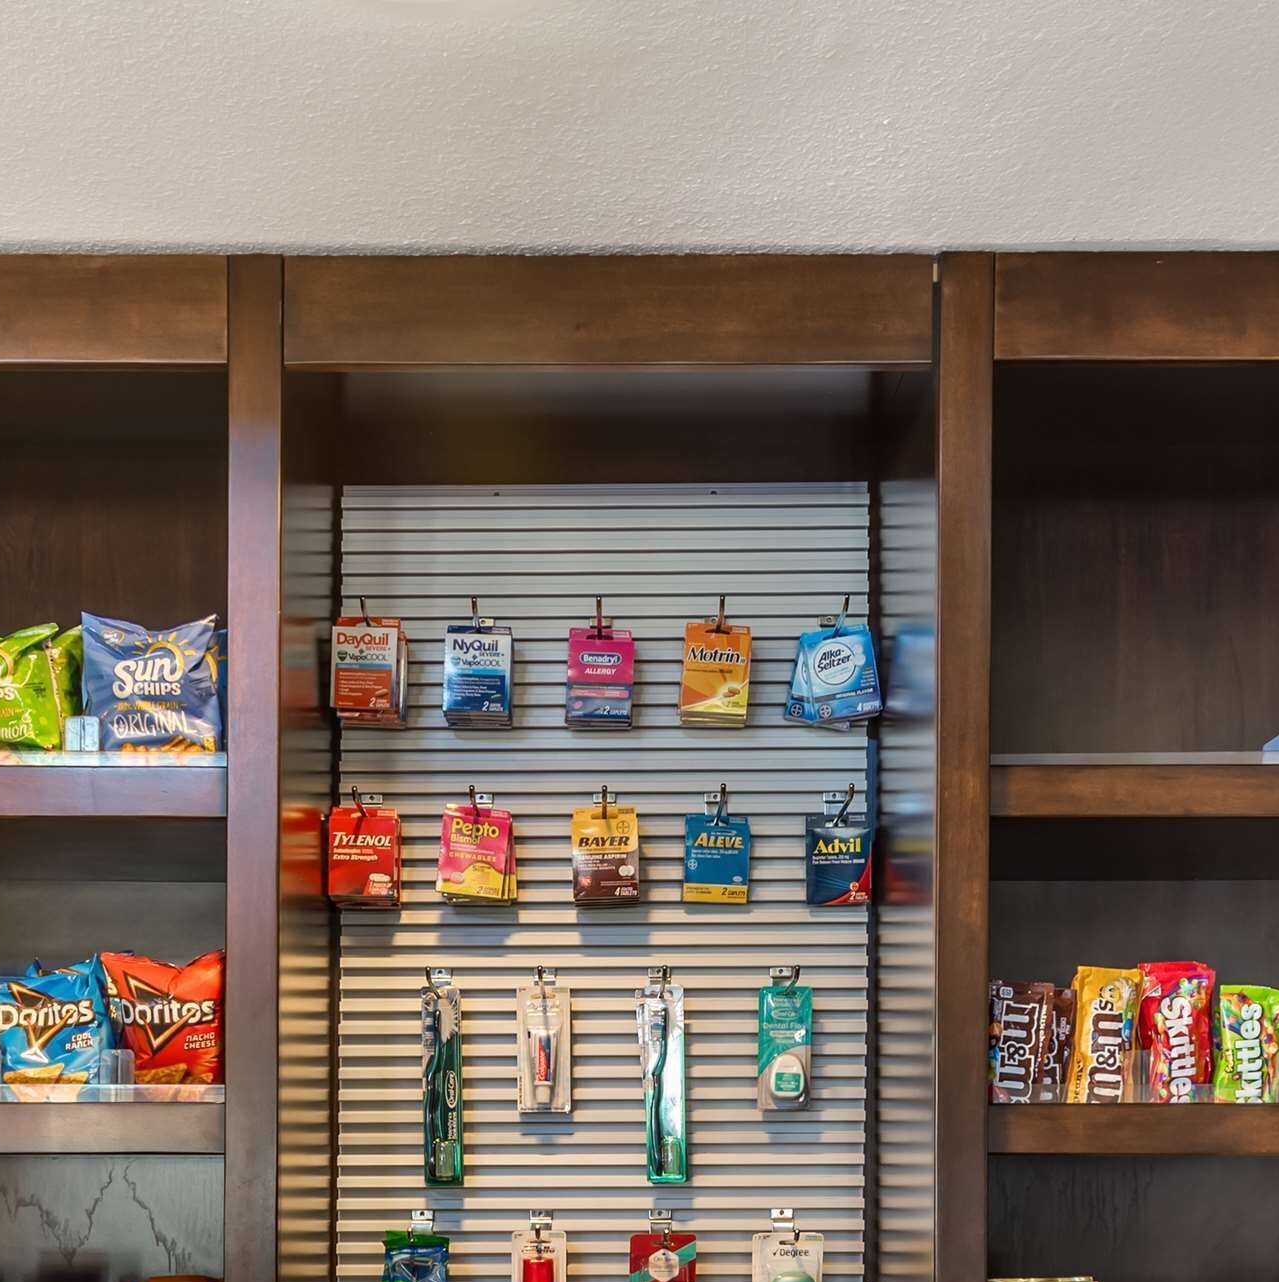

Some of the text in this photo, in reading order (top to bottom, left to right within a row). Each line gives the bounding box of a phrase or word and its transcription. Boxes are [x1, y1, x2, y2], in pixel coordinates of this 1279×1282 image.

[336, 632, 389, 648] DayQuil
[453, 639, 498, 654] NyQuil
[583, 654, 618, 665] Benadryl
[688, 647, 740, 664] Motrin
[820, 649, 844, 661] Alka-
[818, 654, 851, 672] Seltzer
[113, 657, 184, 698] Sun
[134, 682, 181, 695] CHIPS
[482, 701, 489, 711] 2
[113, 711, 196, 738] ORIGINAL
[452, 818, 499, 838] Pepto
[333, 832, 391, 846] TYLENOL
[578, 836, 630, 848] BAYER
[694, 832, 744, 848] ALEVE
[813, 837, 861, 853] Advil
[121, 999, 215, 1025] Doritos
[72, 1032, 93, 1043] COOL
[185, 1032, 215, 1042] NACHO
[65, 1041, 93, 1050] RANCH
[184, 1041, 216, 1050] CHEESE
[780, 1249, 809, 1258] Degree
